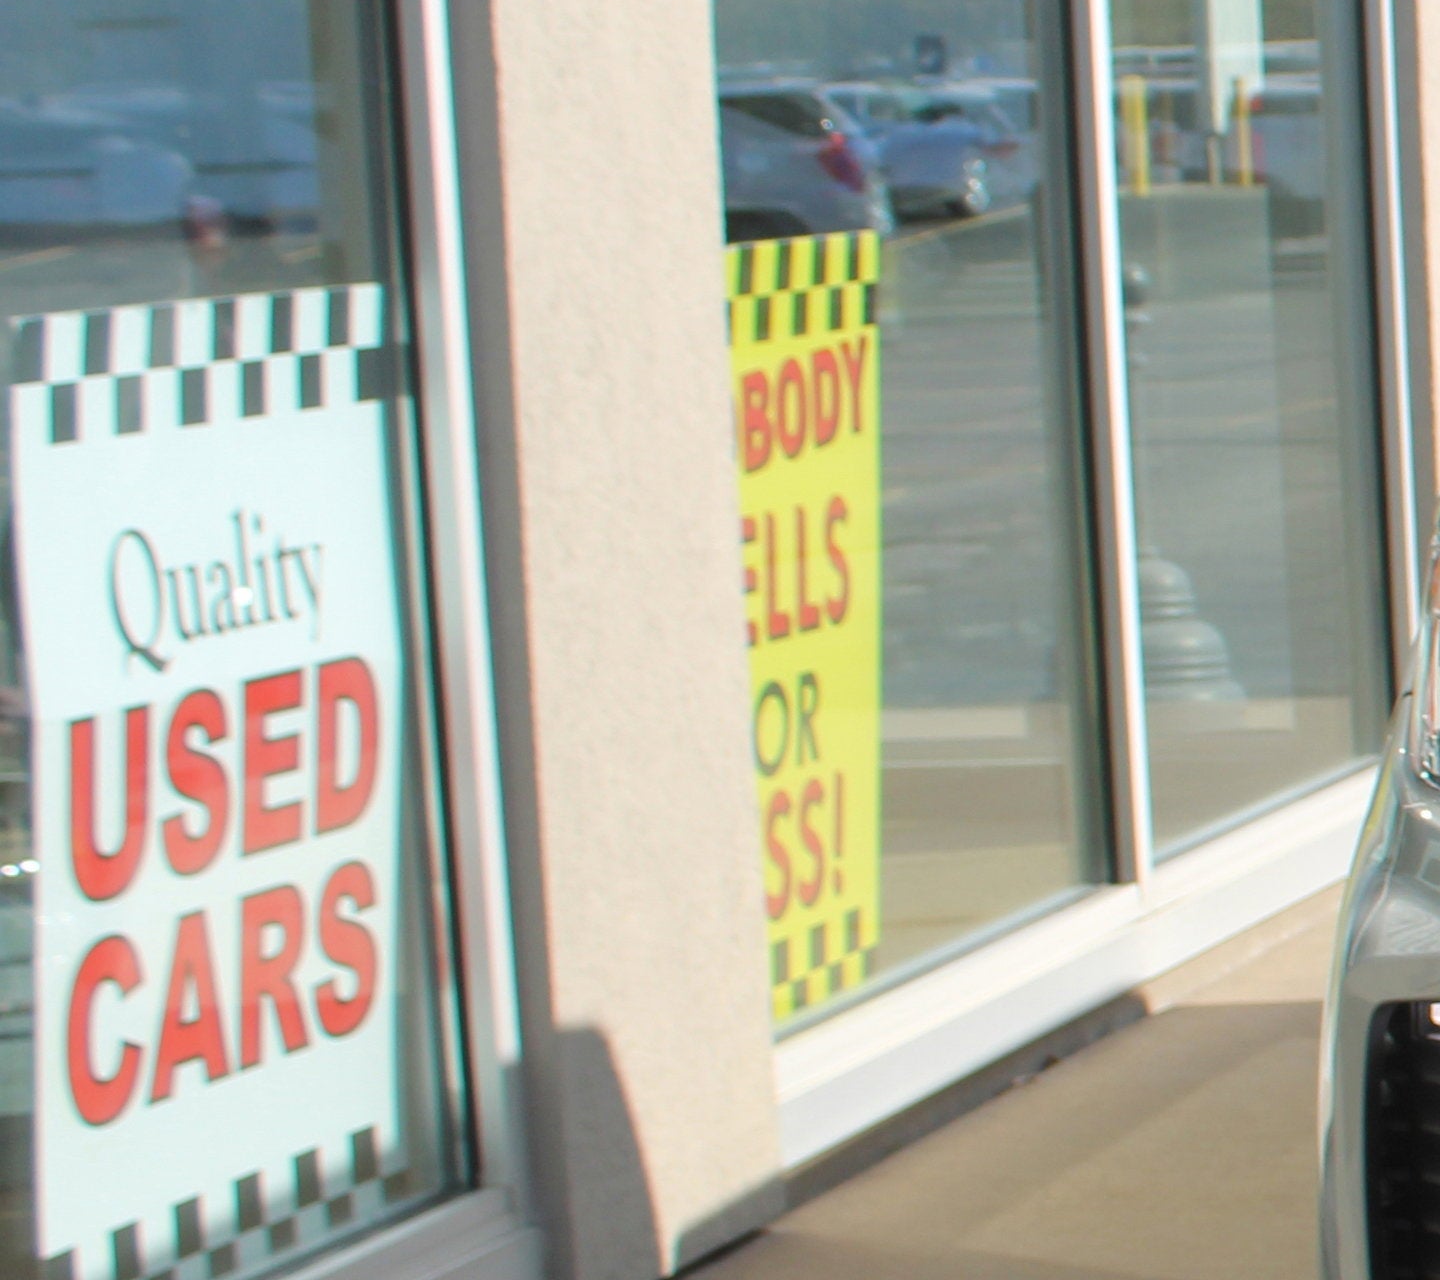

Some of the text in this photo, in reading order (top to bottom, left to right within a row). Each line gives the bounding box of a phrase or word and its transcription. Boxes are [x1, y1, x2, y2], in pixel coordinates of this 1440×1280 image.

[735, 334, 867, 475] BODY
[109, 509, 326, 672] Quality
[68, 655, 381, 904] USED
[66, 860, 380, 1130] CARS
